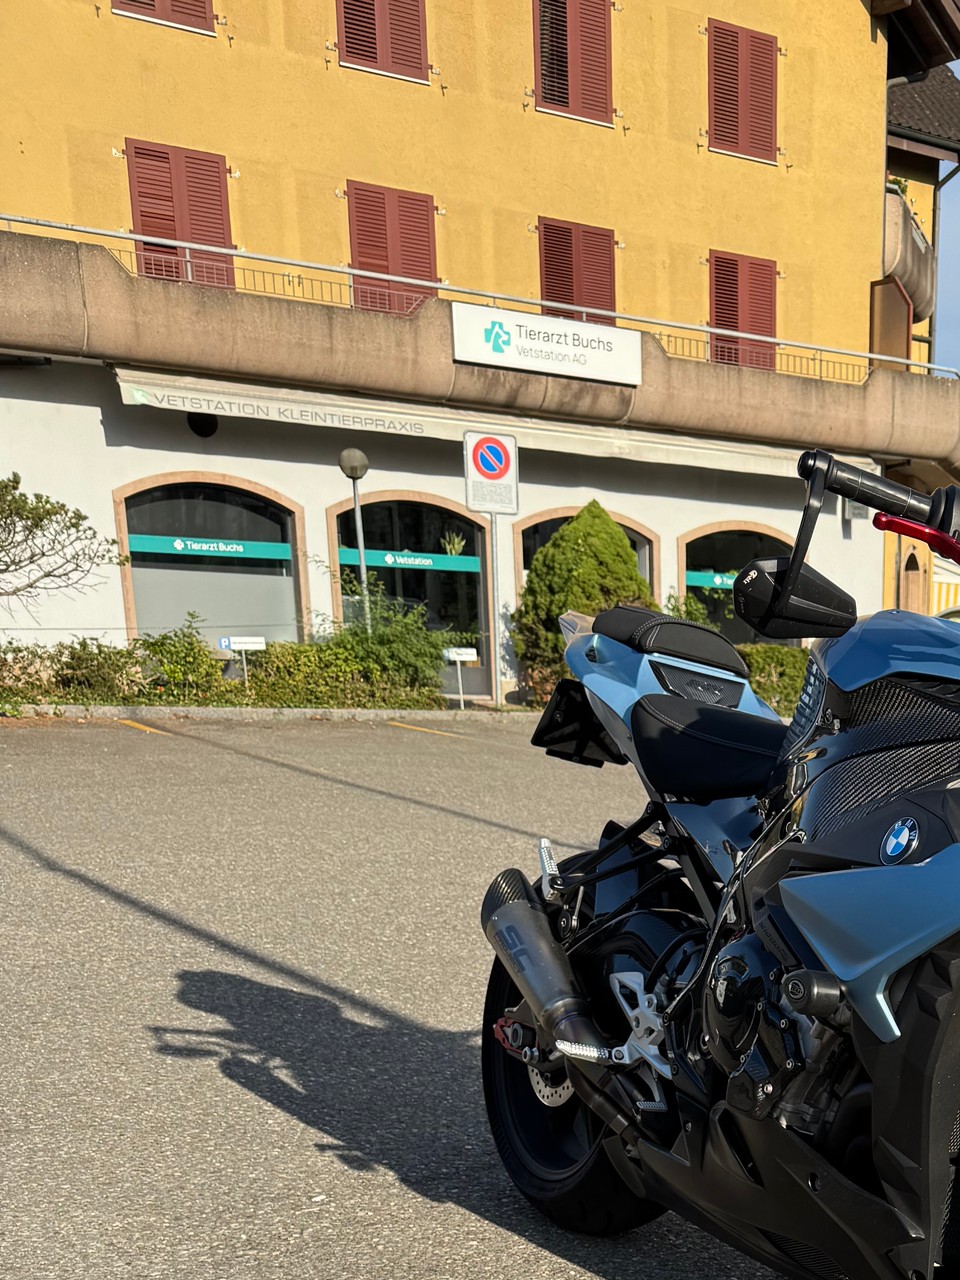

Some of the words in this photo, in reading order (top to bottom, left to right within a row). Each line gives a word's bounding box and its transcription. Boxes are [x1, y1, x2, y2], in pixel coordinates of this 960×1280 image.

[516, 323, 569, 347] Tierarzt
[572, 333, 613, 352] Buchs
[516, 344, 571, 364] Vetstation
[572, 353, 587, 366] AG
[154, 392, 270, 418] VETSTATION
[278, 407, 425, 434] KLEINTIERPRAXIS
[186, 540, 218, 552] Tierarzt
[219, 542, 244, 552] Buchs
[395, 555, 433, 566] Vetstation
[894, 818, 917, 840] BMW
[500, 924, 536, 972] SC
